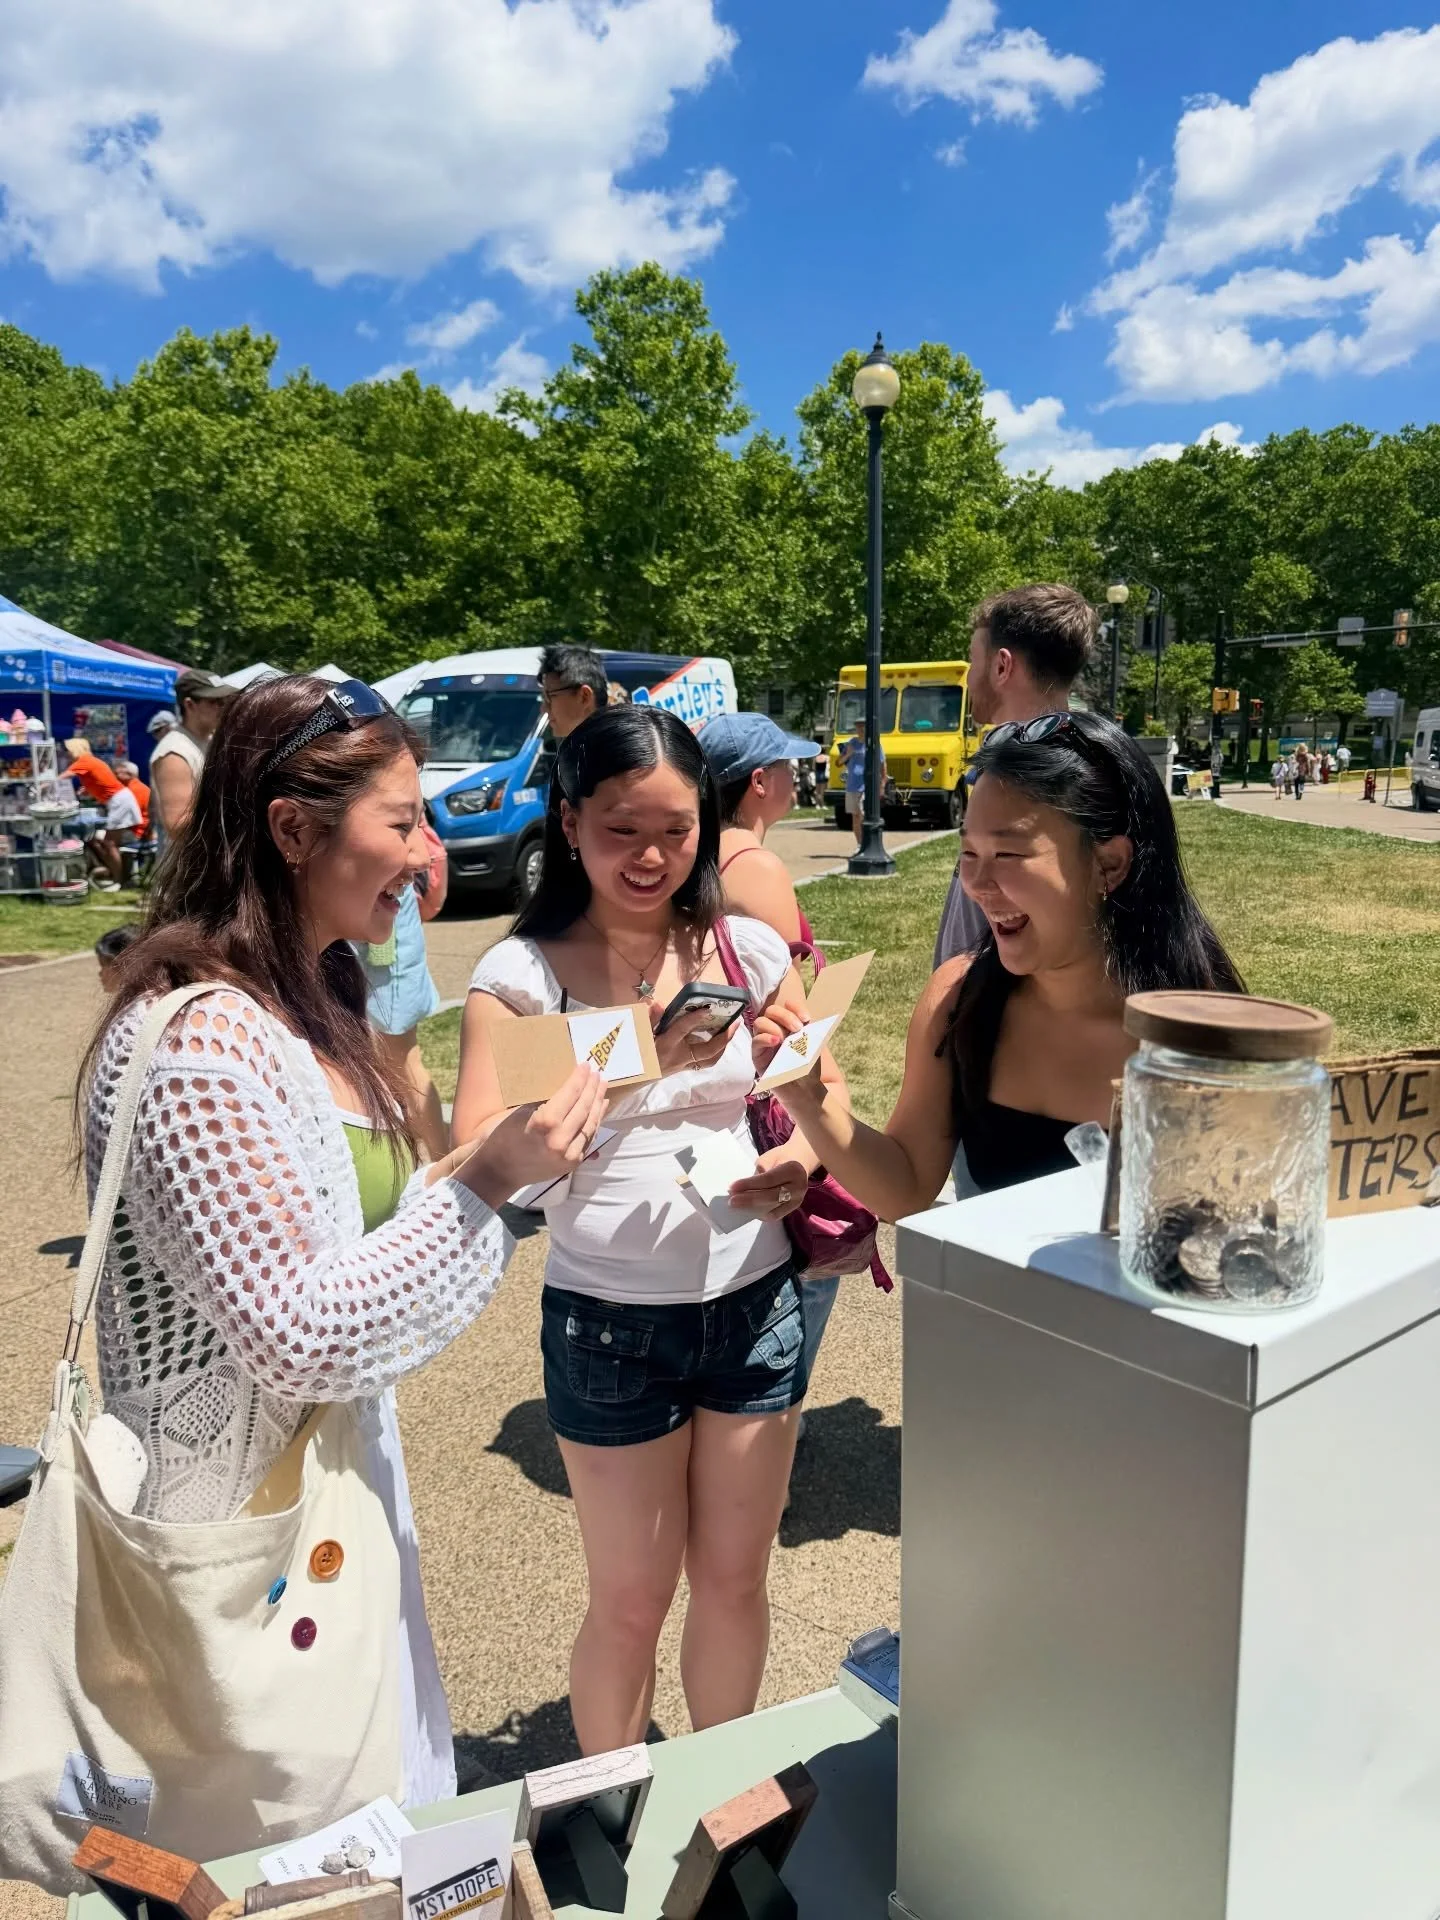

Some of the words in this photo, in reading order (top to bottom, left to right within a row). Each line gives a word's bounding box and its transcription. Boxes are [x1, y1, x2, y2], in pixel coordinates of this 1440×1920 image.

[633, 665, 724, 721] ntley's
[1331, 1071, 1429, 1125] AVE
[74, 1775, 138, 1806] TRAVELING
[87, 1769, 125, 1795] LIVING
[84, 1789, 122, 1811] SHARE
